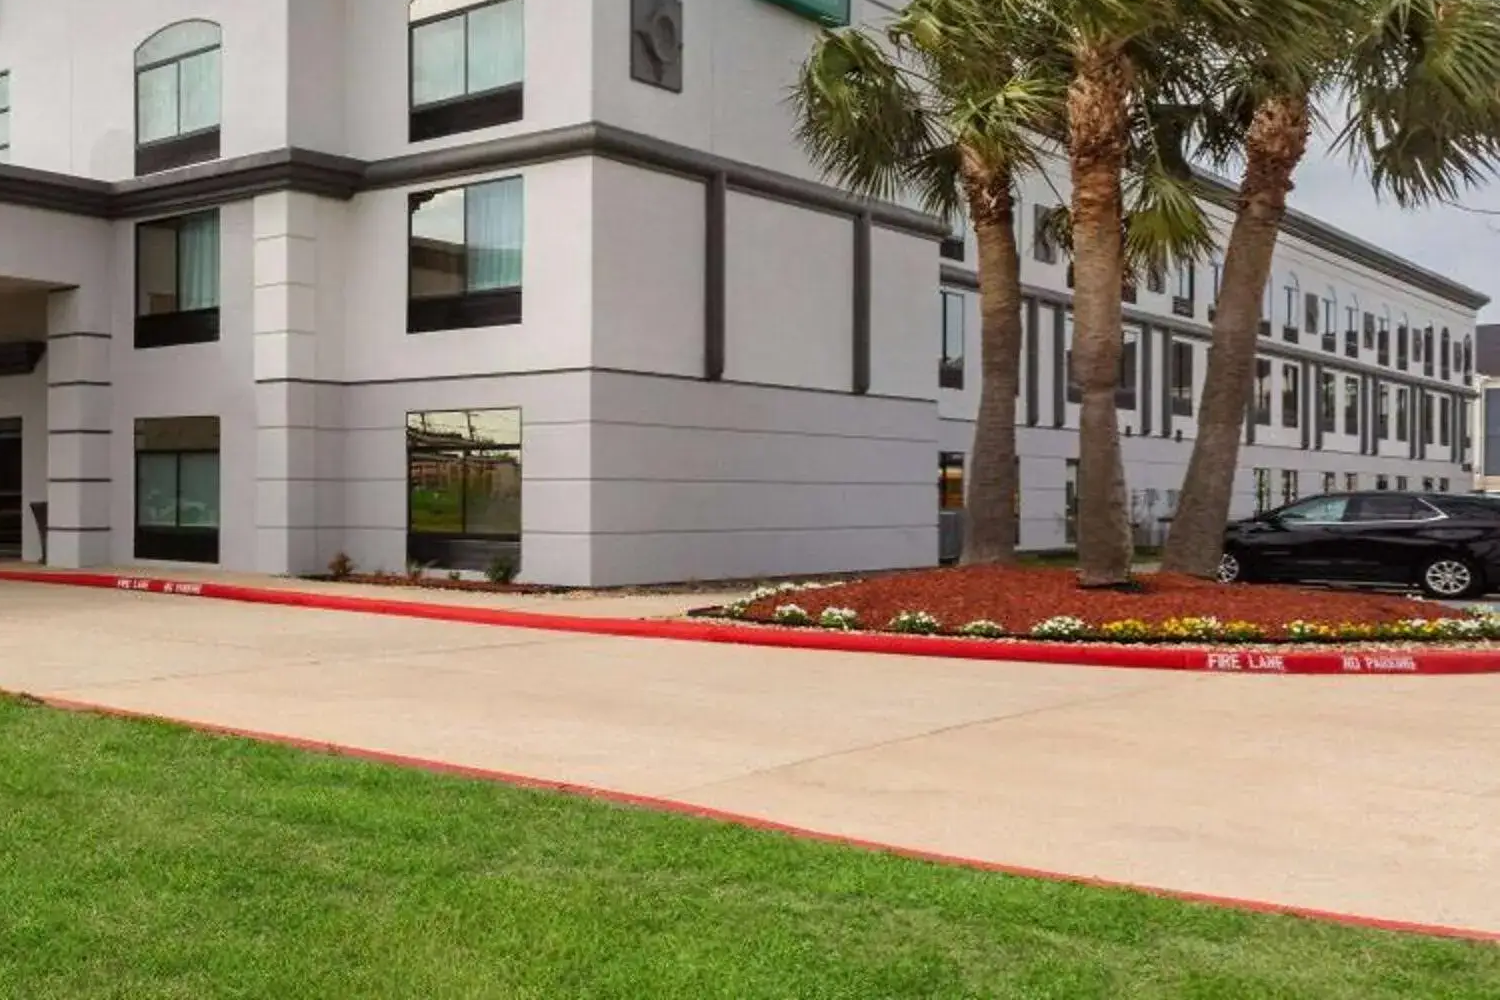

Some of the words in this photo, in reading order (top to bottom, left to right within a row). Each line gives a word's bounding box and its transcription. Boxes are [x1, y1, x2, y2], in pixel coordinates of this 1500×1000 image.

[1207, 653, 1241, 670] FIRE
[1247, 654, 1285, 671] LANE
[1343, 655, 1361, 670] NO
